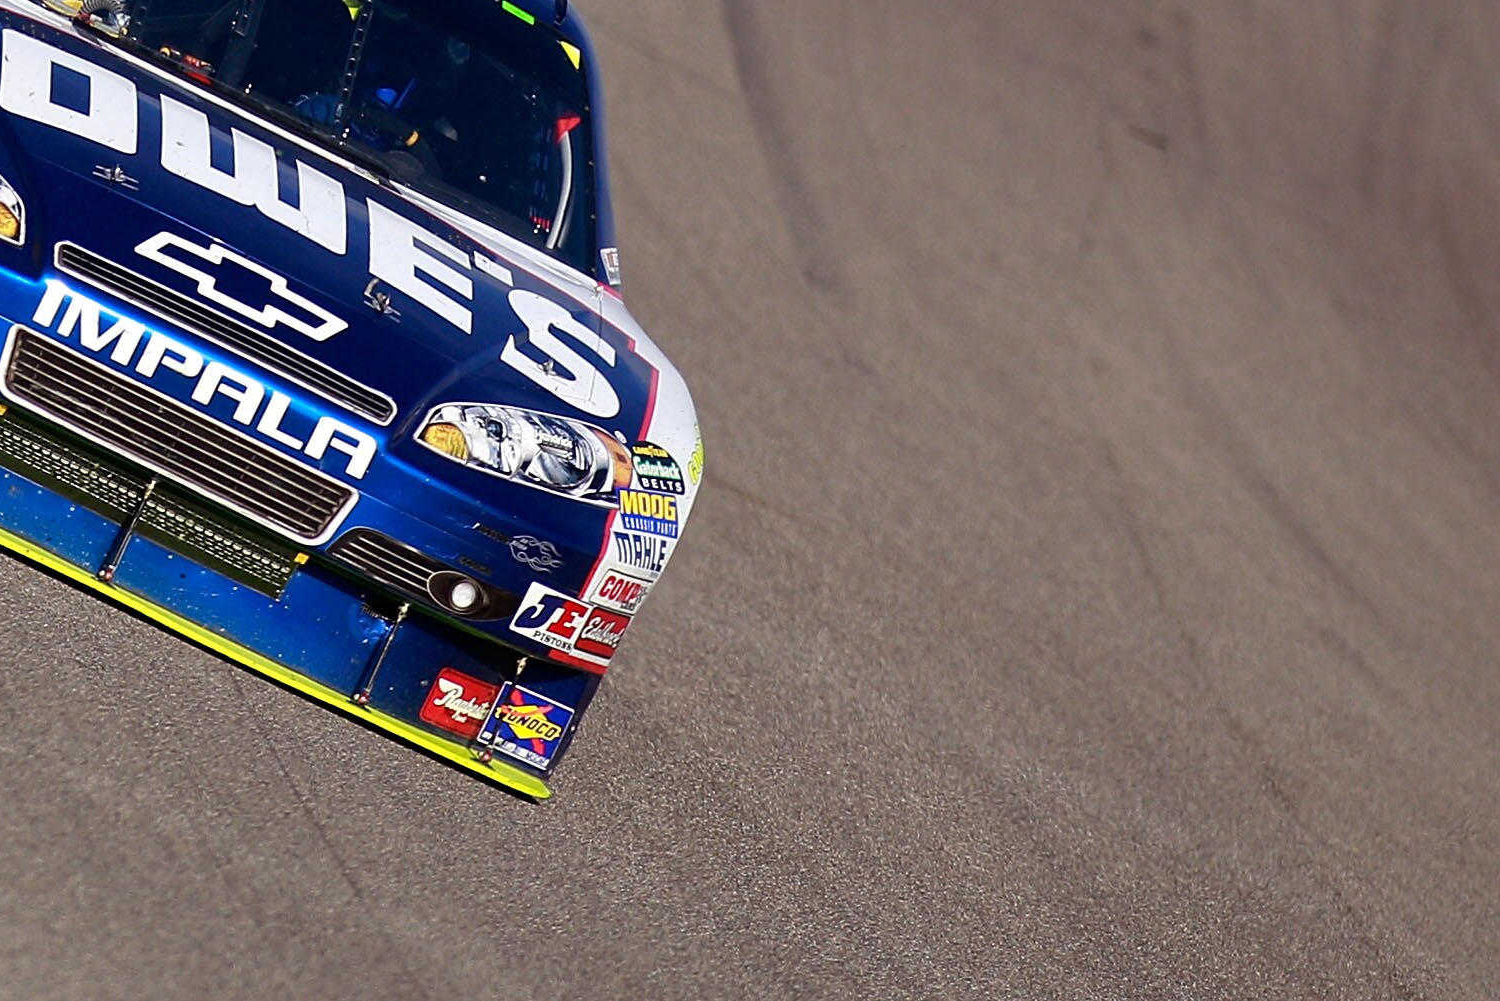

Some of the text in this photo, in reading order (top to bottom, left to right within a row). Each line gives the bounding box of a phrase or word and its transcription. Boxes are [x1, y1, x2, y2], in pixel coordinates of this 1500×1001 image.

[31, 277, 378, 481] IMPALA
[641, 477, 683, 493] BELTS
[620, 490, 677, 521] MOOG
[613, 531, 667, 572] MAHLE
[599, 575, 642, 605] COMP
[514, 593, 589, 640] JE
[532, 629, 573, 652] PISTONS
